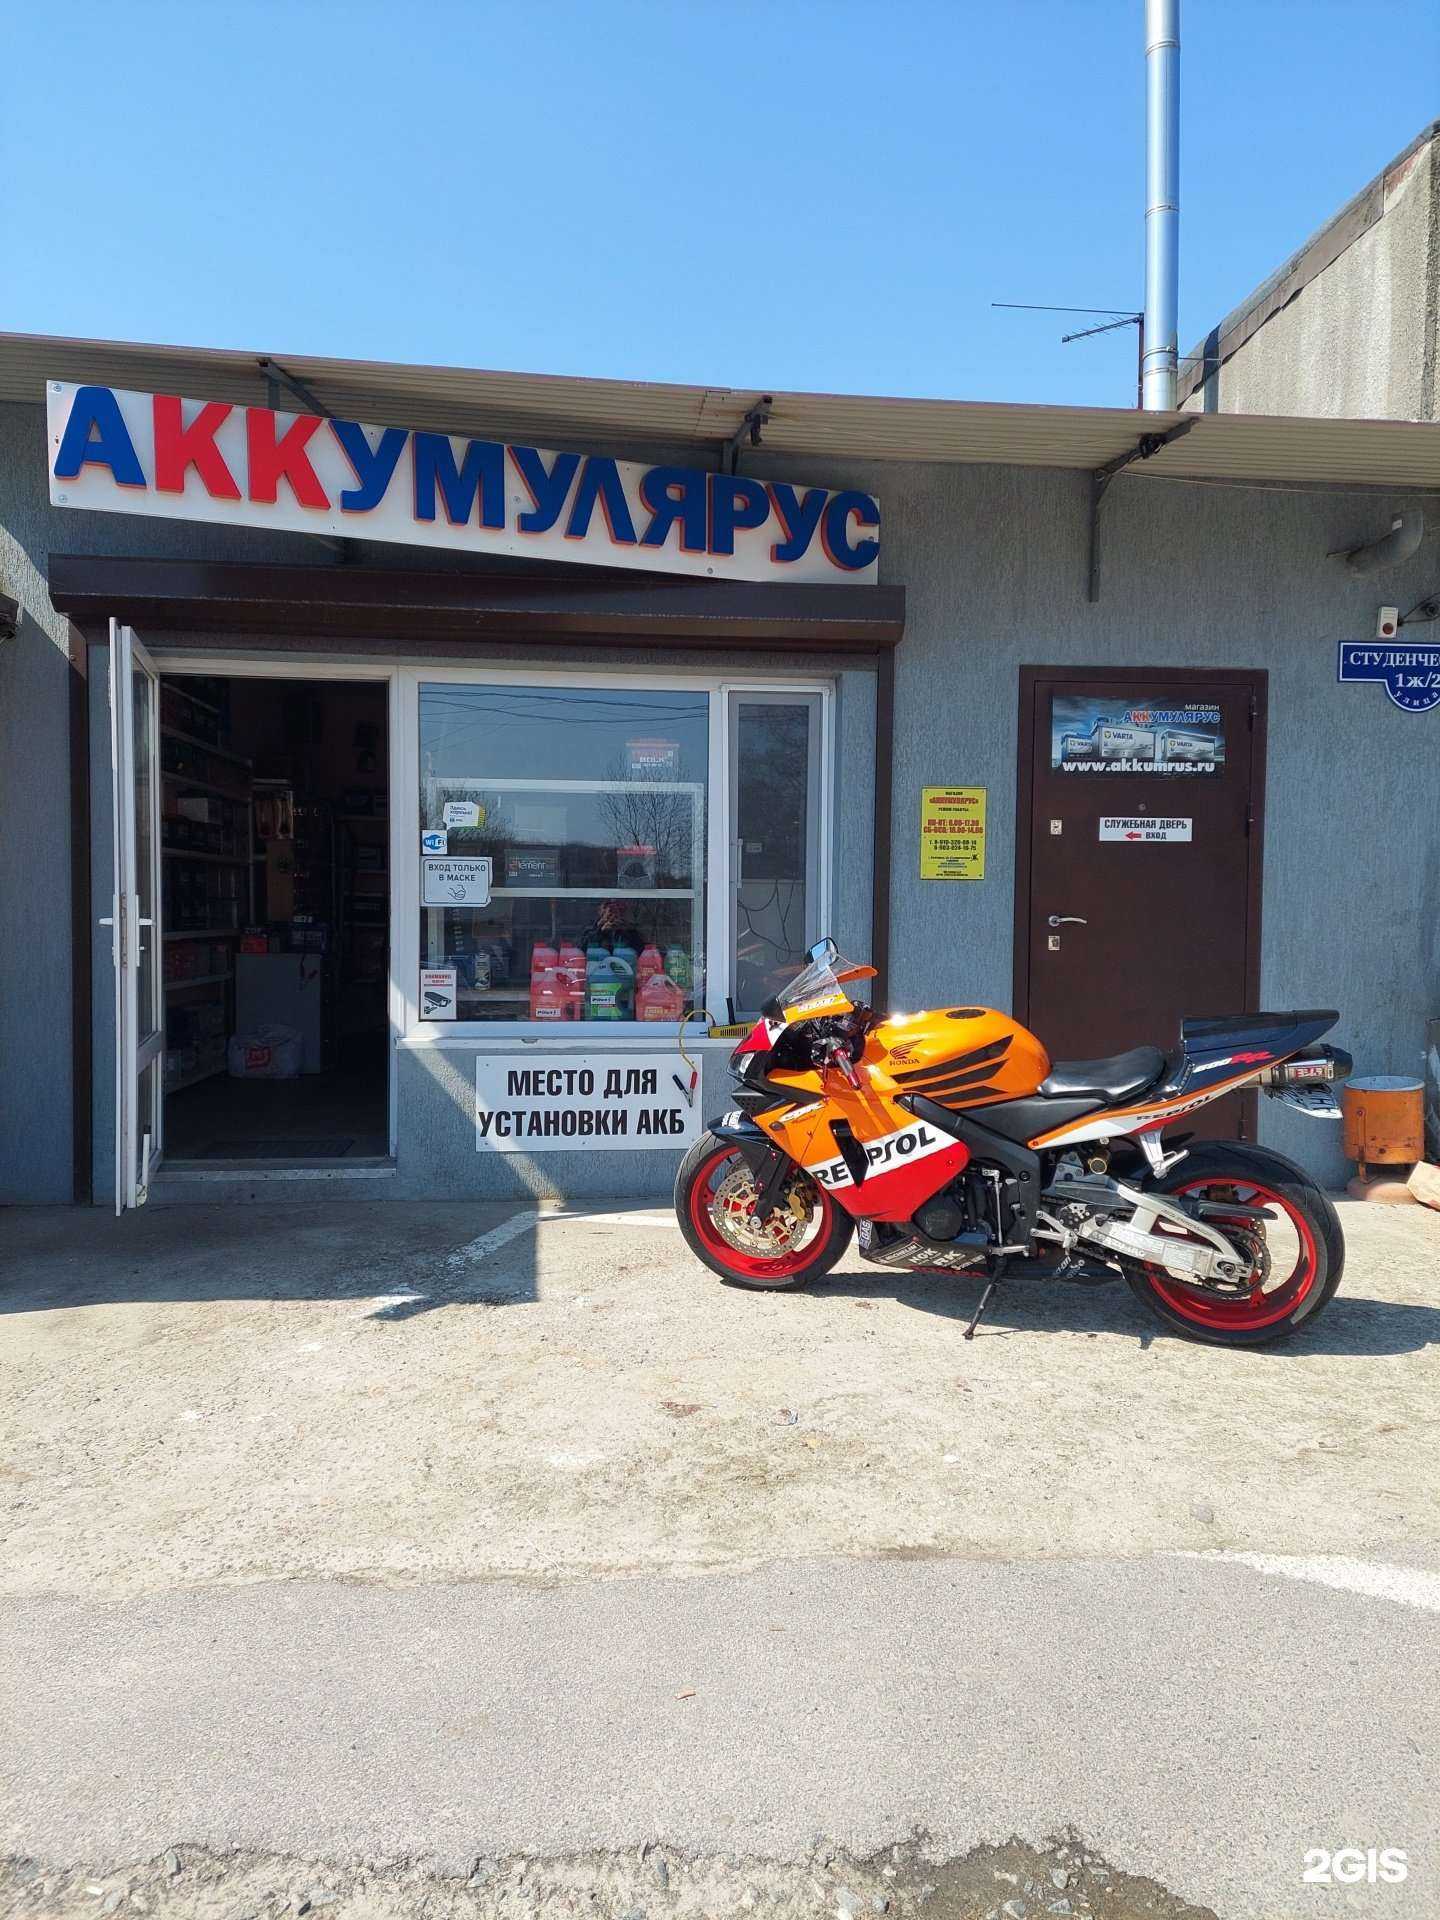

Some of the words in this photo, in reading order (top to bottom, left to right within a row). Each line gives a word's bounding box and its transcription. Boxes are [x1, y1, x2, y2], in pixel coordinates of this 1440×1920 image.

[53, 385, 881, 572] АККУМУЛЯРУС
[1350, 651, 1440, 667] СТУДЕНЧЕ
[1185, 703, 1220, 711] магазин
[1123, 710, 1221, 723] АККУМУЛЯРУС
[1112, 731, 1133, 740] VARTA
[1176, 740, 1193, 748] VARTA
[1062, 758, 1216, 773] www.akkumrus.ru
[1104, 819, 1157, 829] СЛУЖЕБНАЯ
[1158, 819, 1187, 829] ДВЕРЬ
[1145, 832, 1167, 840] ВХОД
[428, 864, 450, 872] ВХОД
[452, 864, 486, 872] ТОЛЬКО
[889, 1058, 920, 1067] HONDA
[507, 1069, 594, 1097] МЕСТО
[603, 1069, 657, 1098] ДЛЯ
[478, 1109, 627, 1138] УСТАНОВКИ
[636, 1108, 684, 1135] АКБ
[910, 1248, 938, 1264] NGK
[933, 1250, 962, 1266] RK
